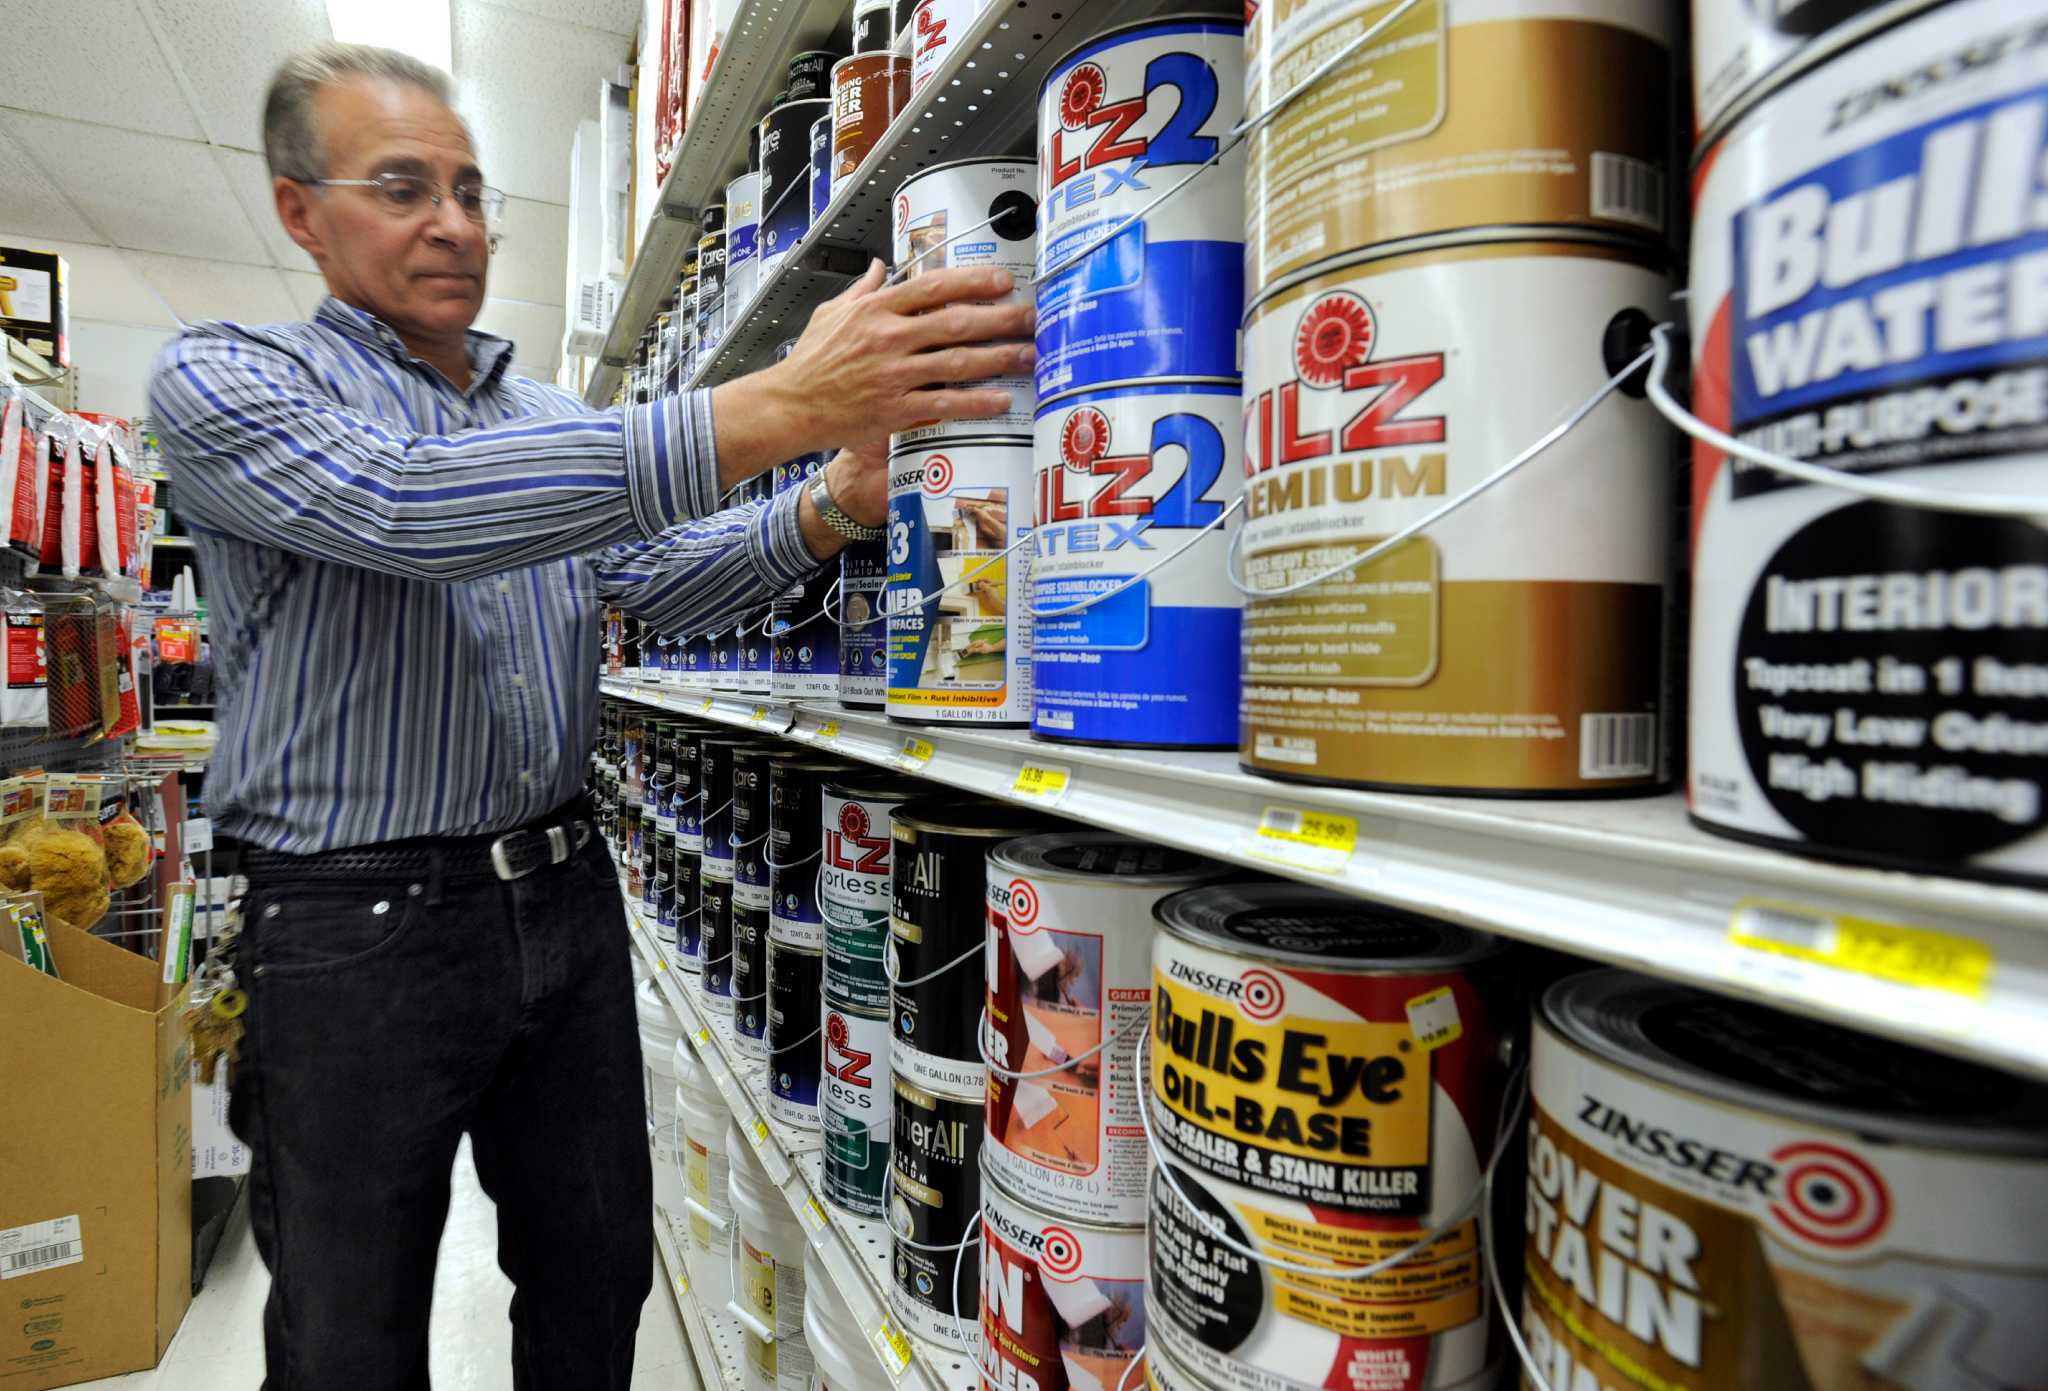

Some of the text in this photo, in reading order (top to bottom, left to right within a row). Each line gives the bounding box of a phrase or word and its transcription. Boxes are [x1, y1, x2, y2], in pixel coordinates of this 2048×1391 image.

[839, 77, 863, 93] CKING
[1046, 158, 1152, 223] TEX
[1244, 289, 1446, 480] ILZ
[1249, 453, 1447, 520] EMIUM
[1034, 519, 1158, 558] ATEX
[1876, 655, 1927, 695] in
[1932, 656, 1962, 696] 1
[942, 710, 973, 719] GALLON
[952, 694, 998, 703] Inhibitive
[1757, 704, 1832, 748] Very
[825, 801, 890, 875] ILZ
[825, 871, 890, 897] orless
[1110, 990, 1146, 1001] GREAT
[1169, 959, 1243, 997] ZINSSER
[1111, 1004, 1146, 1013] Primin
[1156, 984, 1407, 1107] Bulls Eye
[826, 1076, 872, 1109] less
[914, 1062, 928, 1076] ONE
[929, 1065, 962, 1085] GALLON
[1162, 1063, 1372, 1157] OIL-BASE
[1576, 1093, 1780, 1200] ZINSSER
[1013, 1155, 1051, 1184] GALLON
[1244, 1148, 1263, 1173] &
[1269, 1155, 1336, 1190] STAIN
[1342, 1168, 1418, 1196] KILLER
[984, 1200, 1044, 1252] ZINSSER
[1213, 1243, 1249, 1275] Flat
[933, 1322, 949, 1338] ONE
